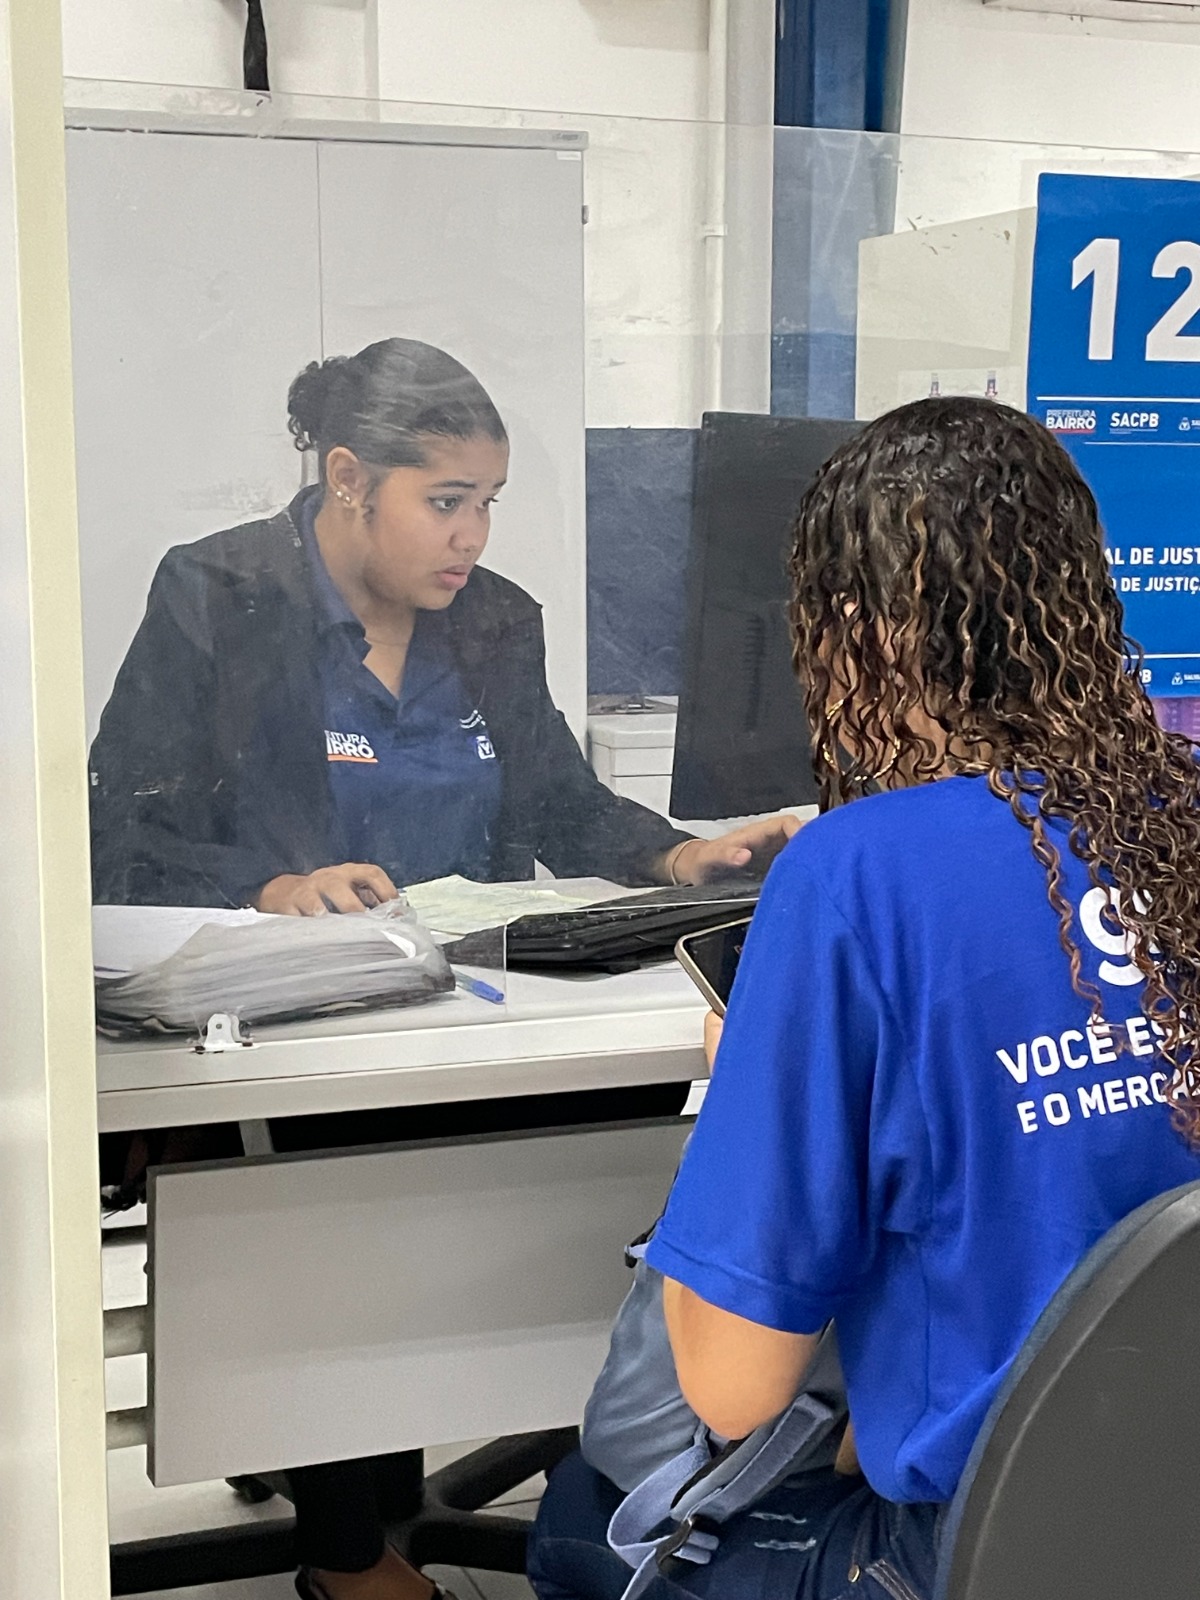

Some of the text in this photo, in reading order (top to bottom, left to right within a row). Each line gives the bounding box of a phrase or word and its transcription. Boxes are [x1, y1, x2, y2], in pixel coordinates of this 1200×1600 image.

[1047, 409, 1097, 418] PREFEITURA
[1110, 412, 1160, 428] SACPB
[1046, 416, 1097, 430] BAIRRO
[1129, 547, 1154, 565] DE
[1121, 577, 1141, 592] DE
[1144, 576, 1200, 595] JUSTIÇ
[324, 730, 370, 745] ITURA
[996, 1013, 1117, 1085] VOCÊ
[1017, 1067, 1200, 1134] E O MERCA
